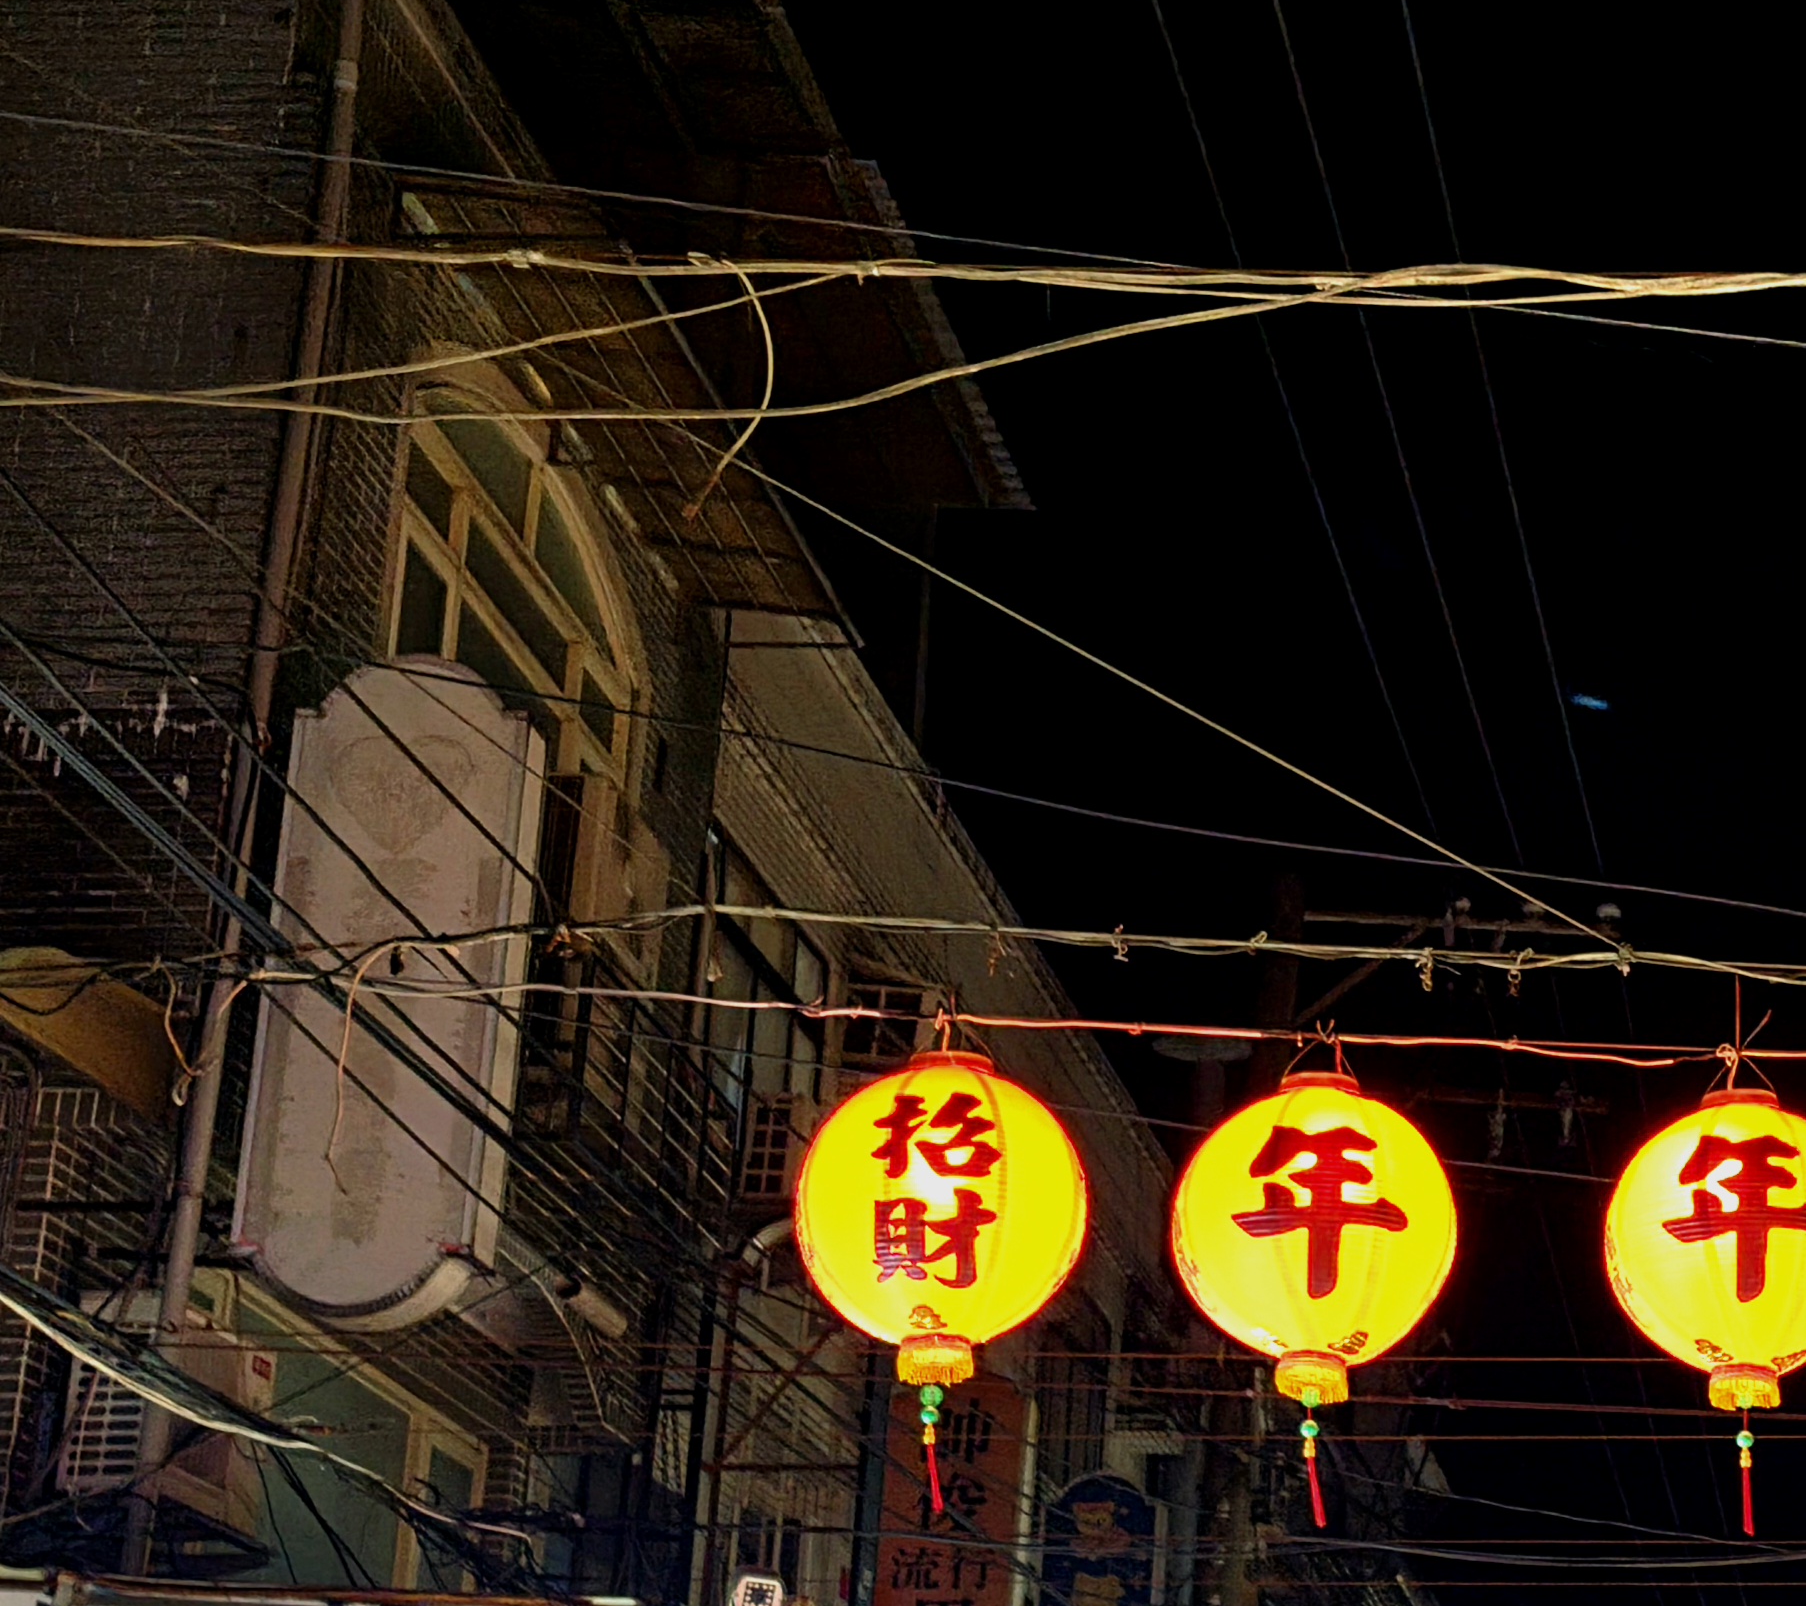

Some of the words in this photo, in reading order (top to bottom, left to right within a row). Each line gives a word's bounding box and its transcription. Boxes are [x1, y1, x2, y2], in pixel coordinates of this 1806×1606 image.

[871, 1091, 1003, 1290] 招財
[1231, 1124, 1409, 1299] 年
[891, 1546, 994, 1591] 流行
